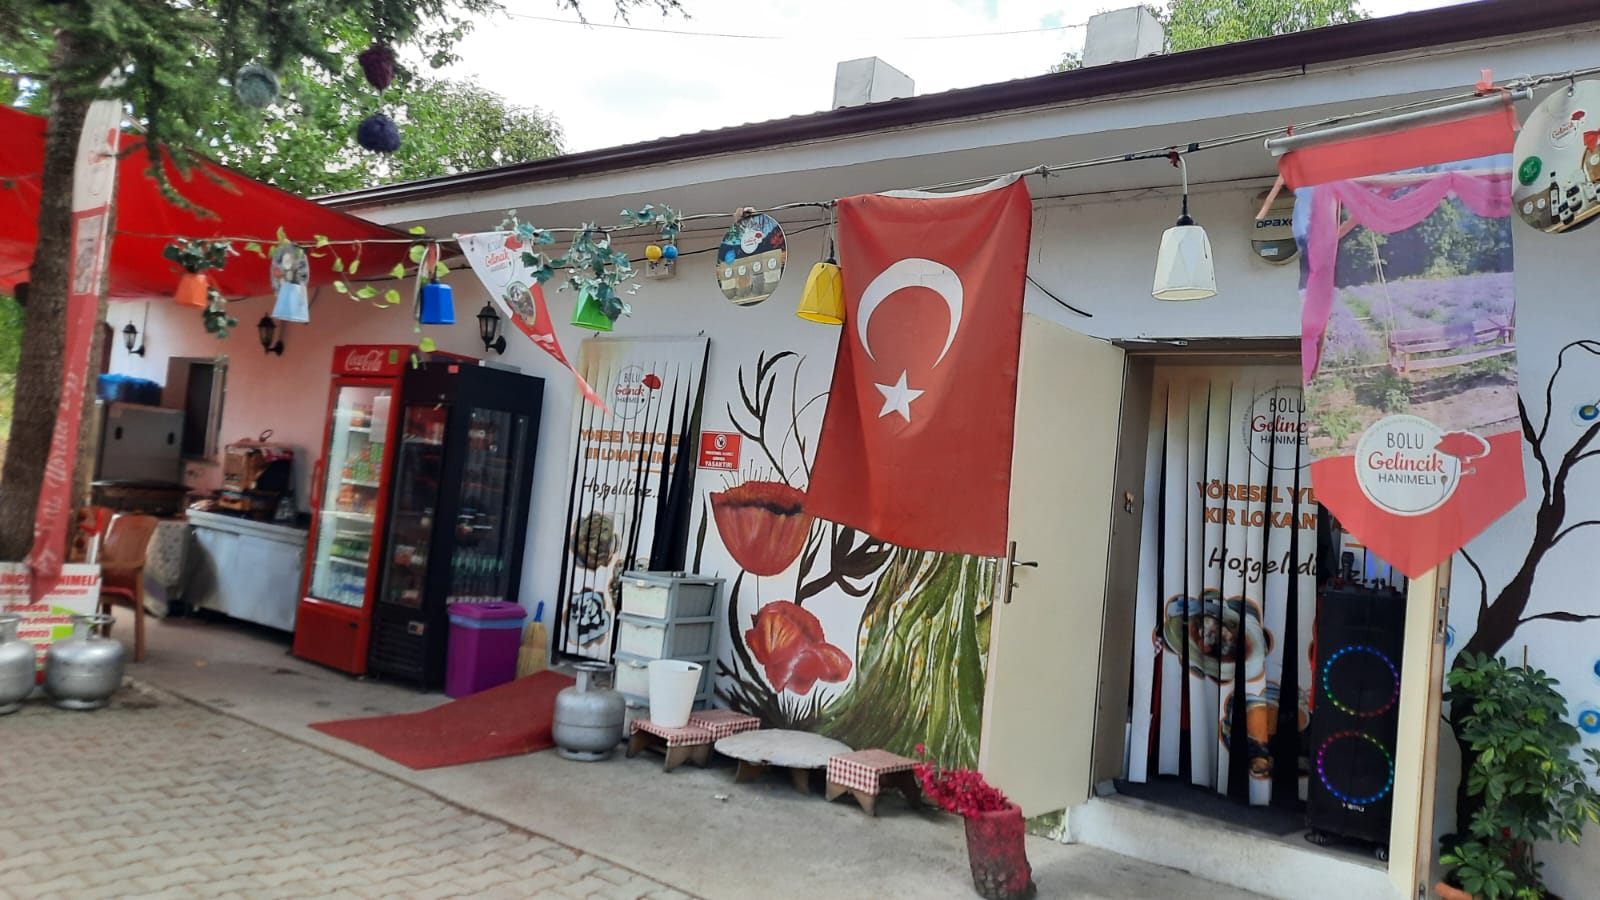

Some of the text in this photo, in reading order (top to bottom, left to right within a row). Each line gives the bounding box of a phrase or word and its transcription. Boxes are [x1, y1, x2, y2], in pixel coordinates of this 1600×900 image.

[1269, 397, 1306, 413] BOLU
[1387, 432, 1425, 449] BOLU
[1368, 451, 1446, 474] Gelincik
[1205, 507, 1236, 526] KIR
